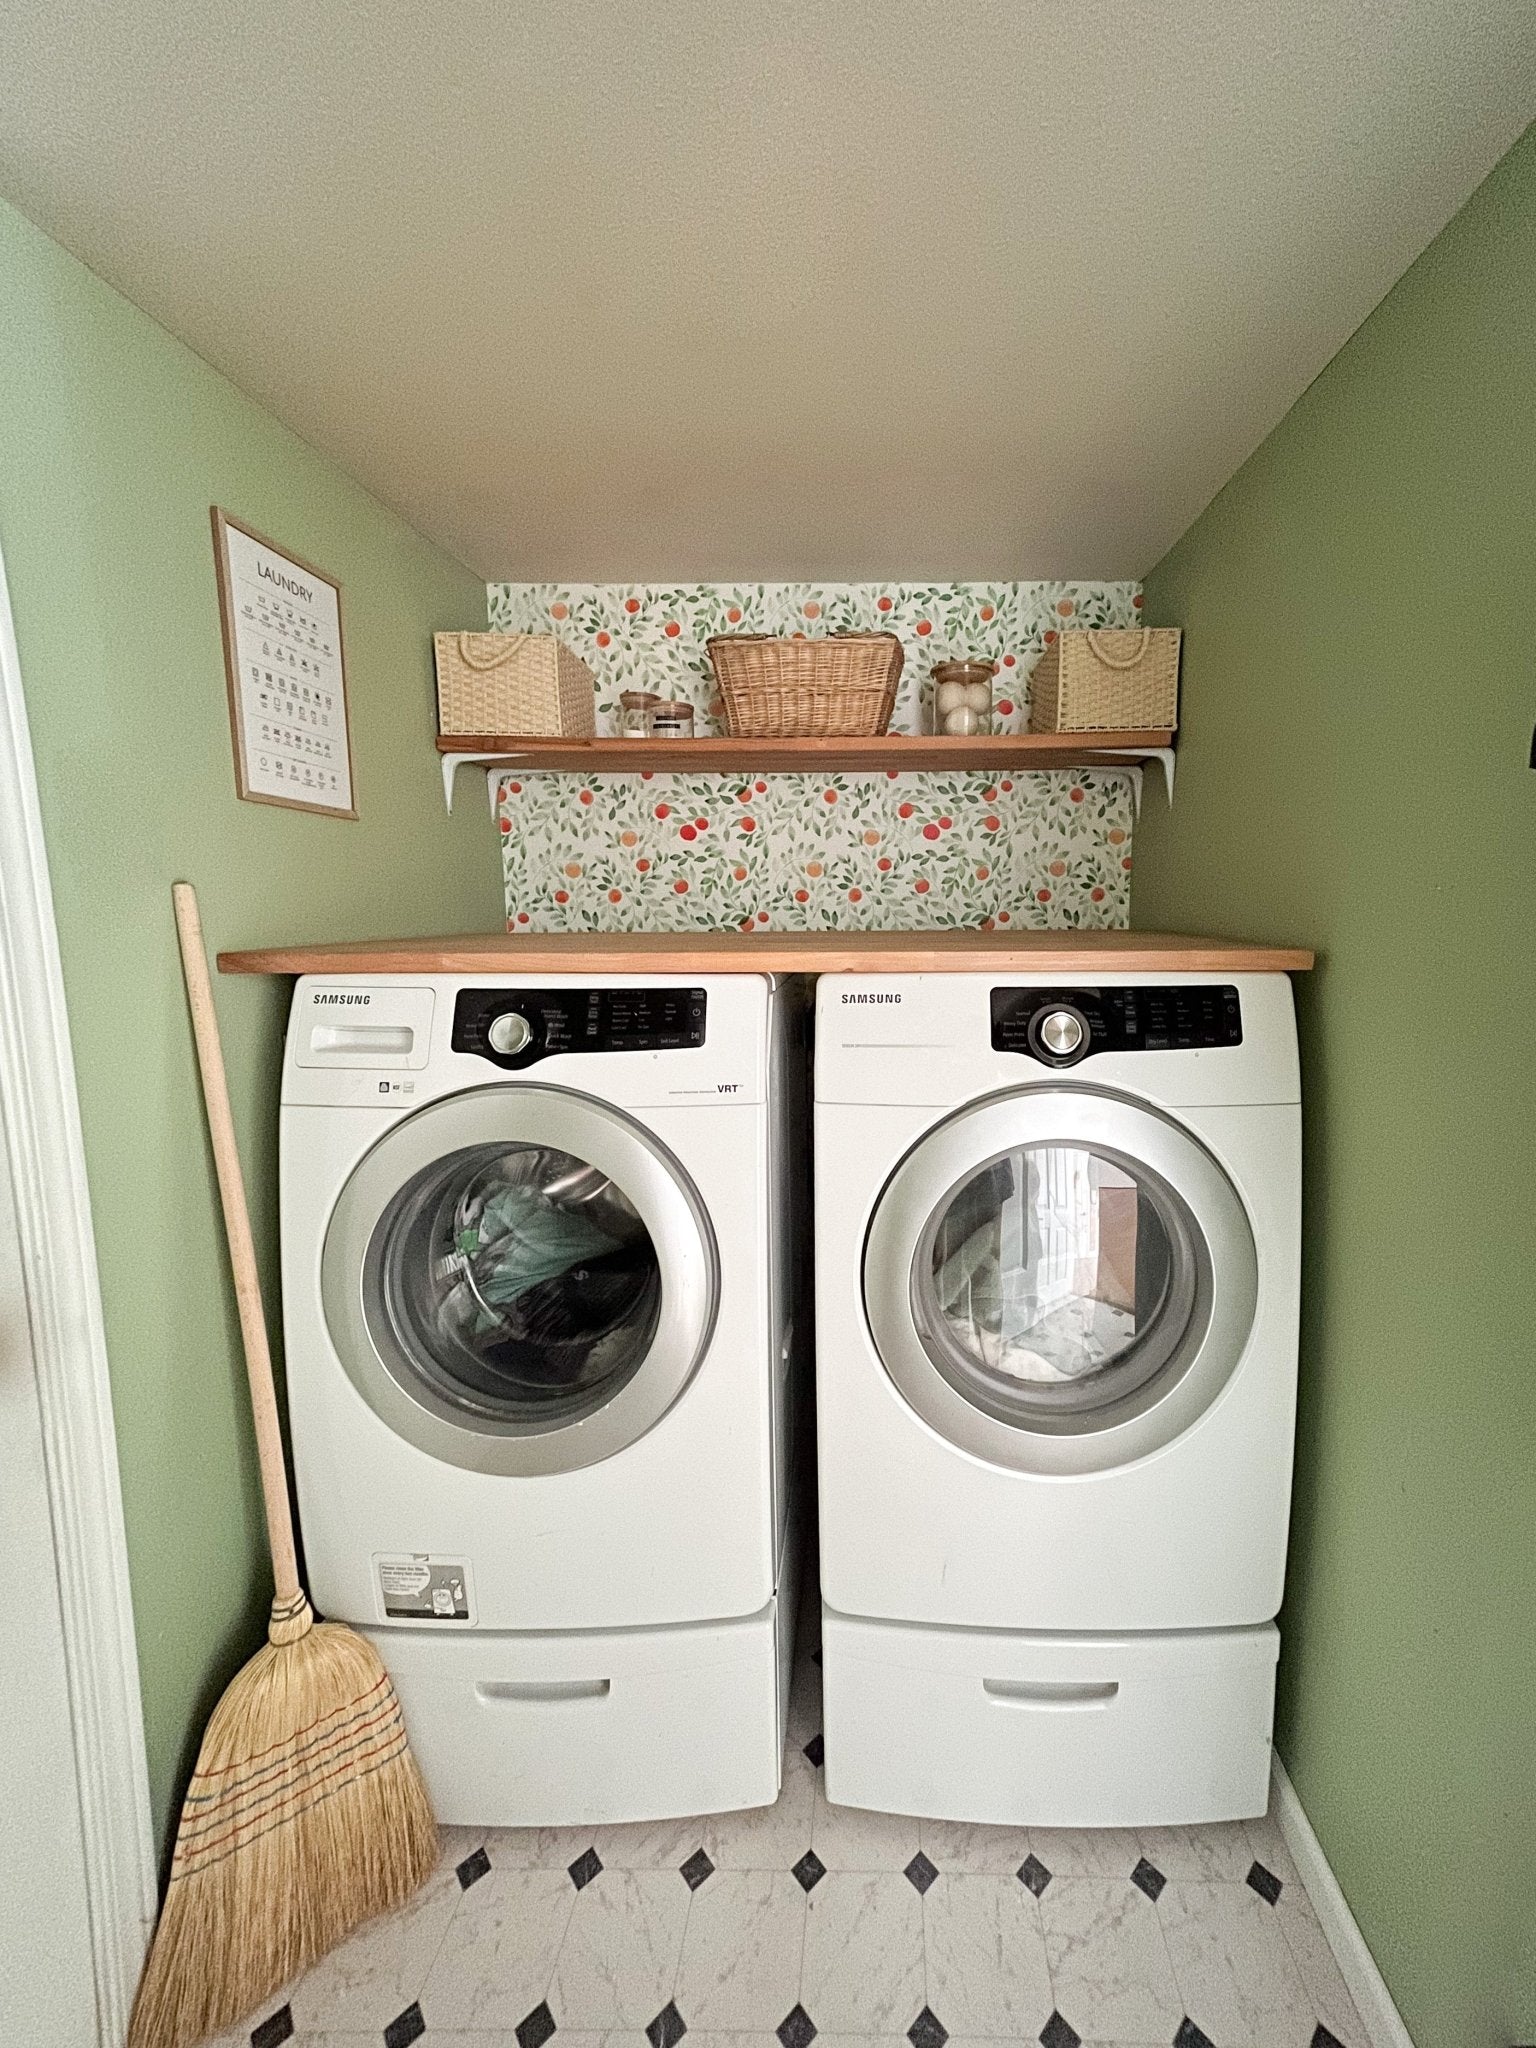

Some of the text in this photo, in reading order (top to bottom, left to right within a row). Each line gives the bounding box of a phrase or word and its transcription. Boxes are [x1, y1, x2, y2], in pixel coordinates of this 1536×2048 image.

[257, 561, 313, 603] LAUNDRY
[313, 994, 371, 1005] SAMSUNG
[841, 994, 902, 1004] SAMSUNG
[717, 1084, 739, 1093] VRT
